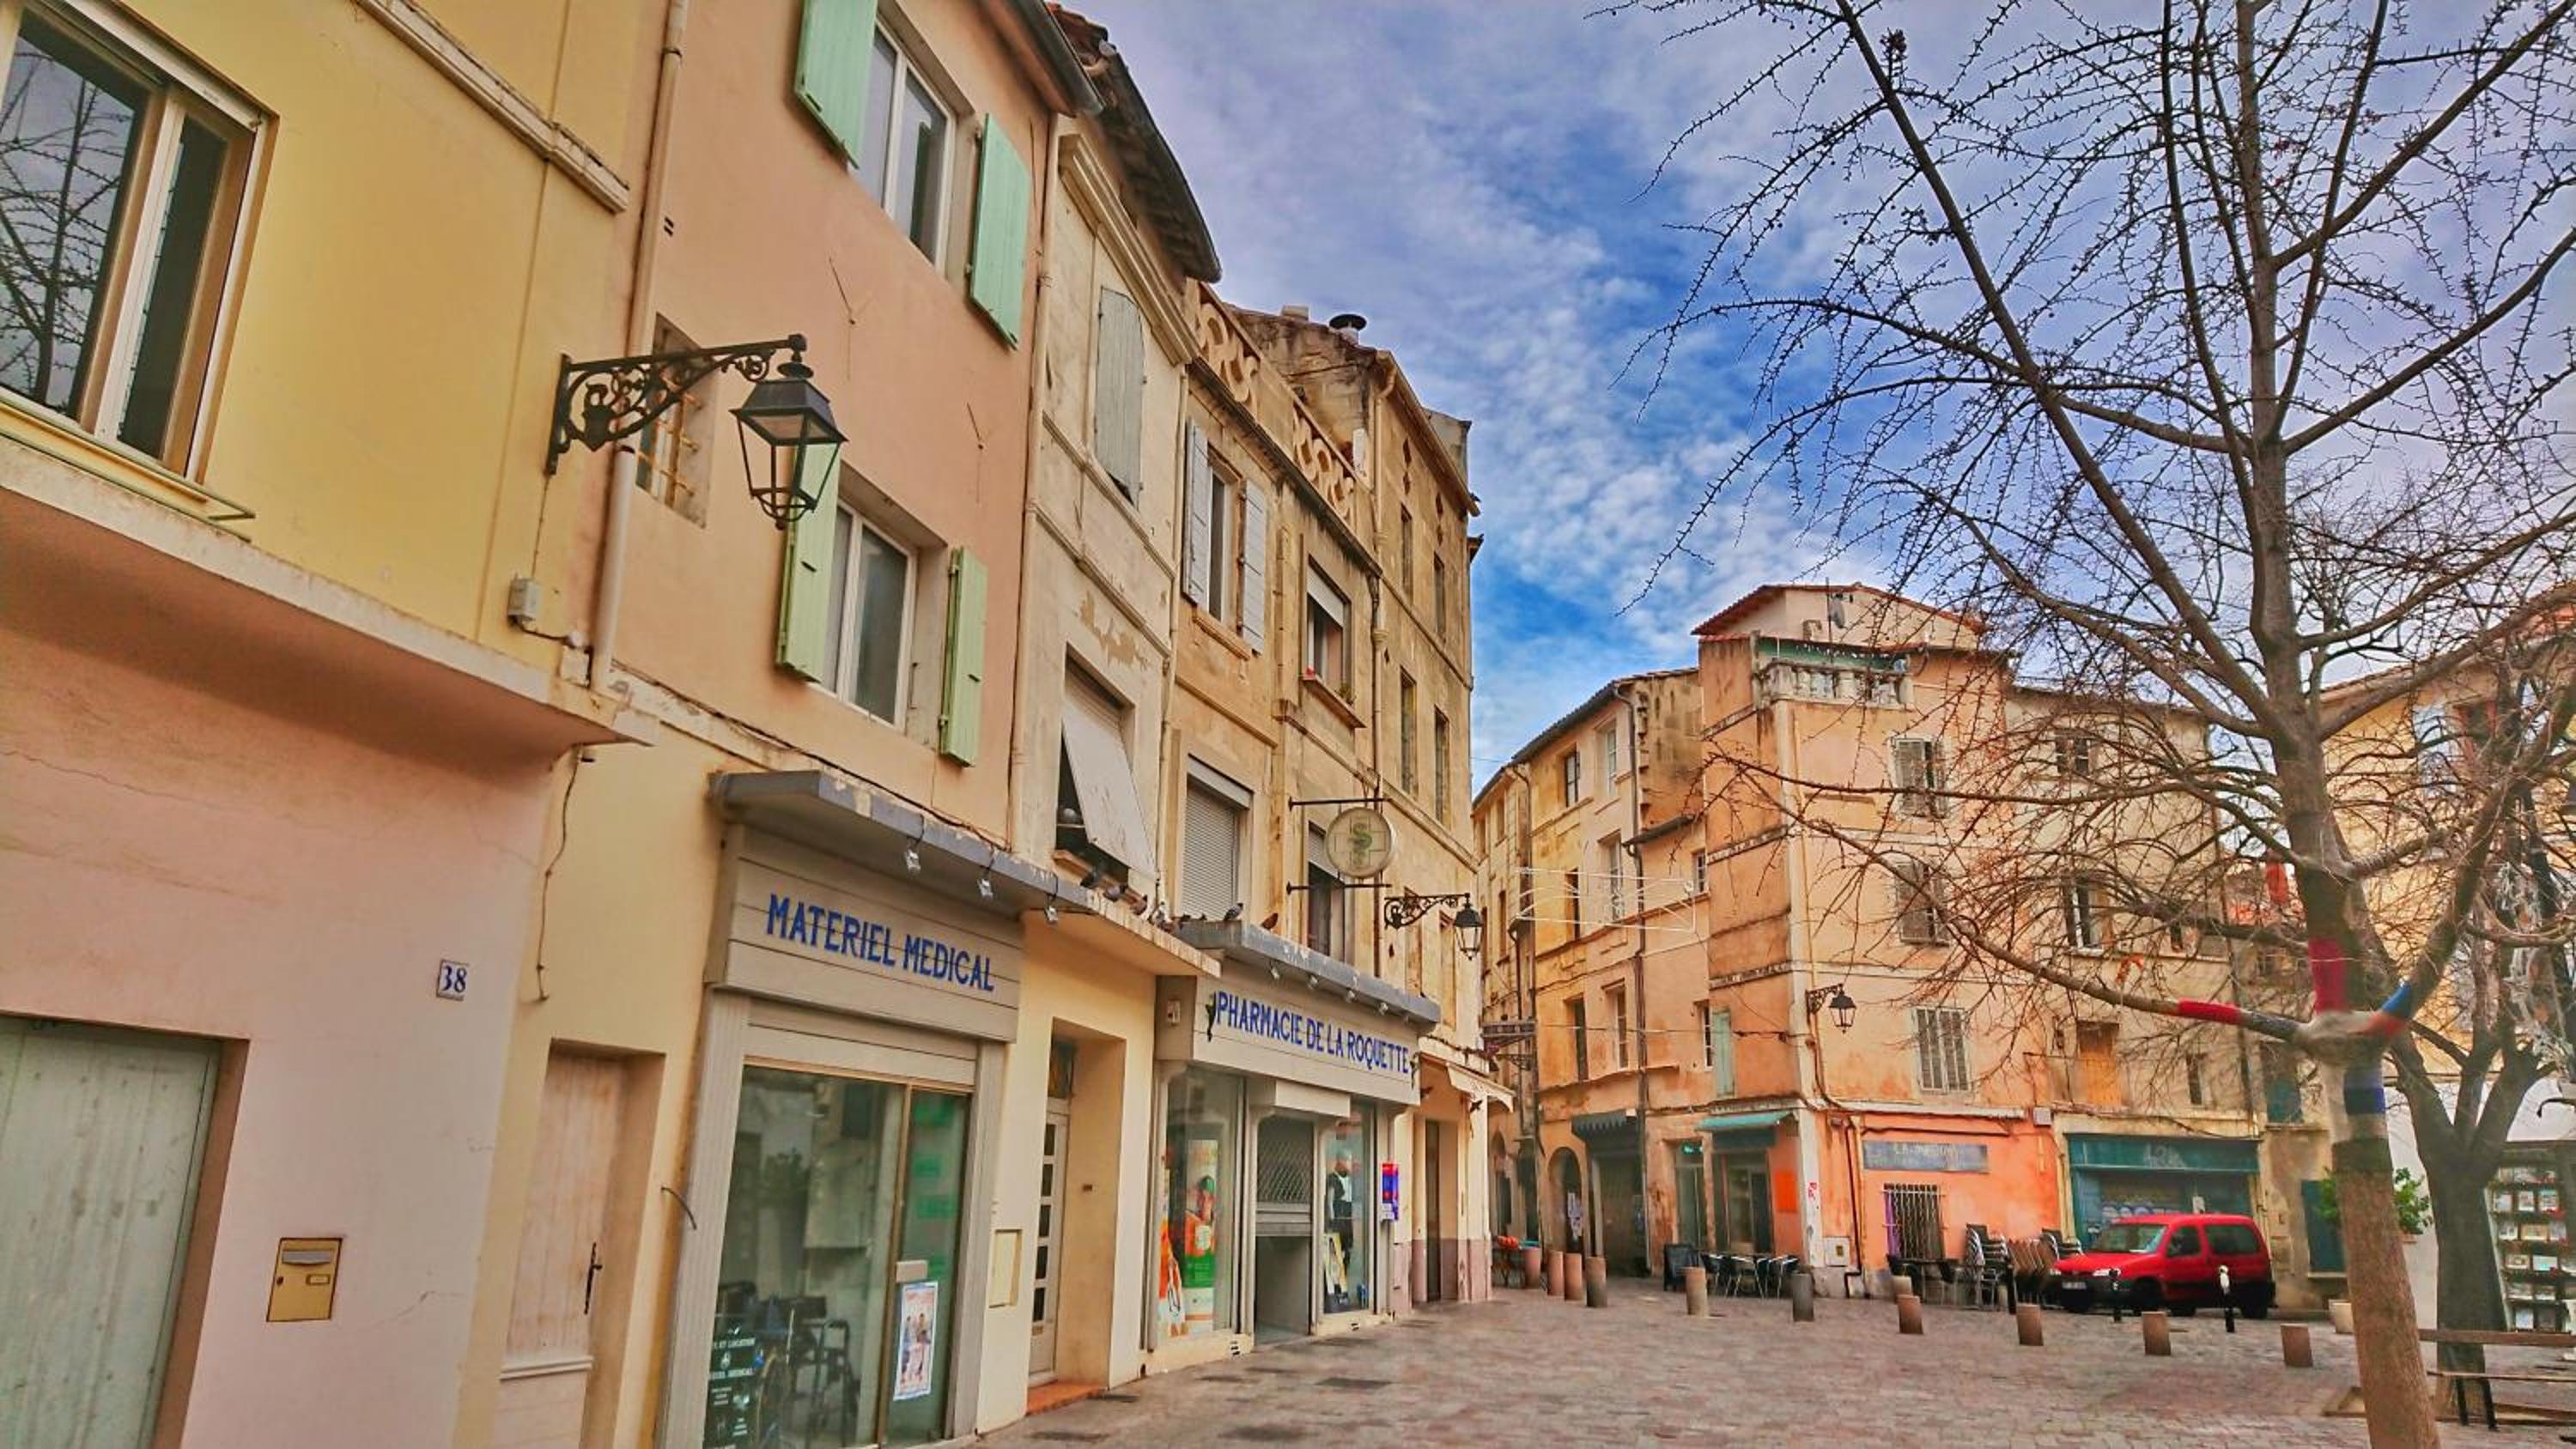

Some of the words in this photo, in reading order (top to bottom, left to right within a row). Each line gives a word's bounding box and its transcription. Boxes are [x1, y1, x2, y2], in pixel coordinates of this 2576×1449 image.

[442, 965, 467, 993] 38
[767, 894, 896, 967] MATERIEL
[903, 934, 994, 992] MEDICAL
[1216, 991, 1303, 1046] PHARMACIE
[1306, 1018, 1324, 1052] DE
[1327, 1025, 1344, 1058] LA
[1347, 1030, 1409, 1074] ROQUETTE
